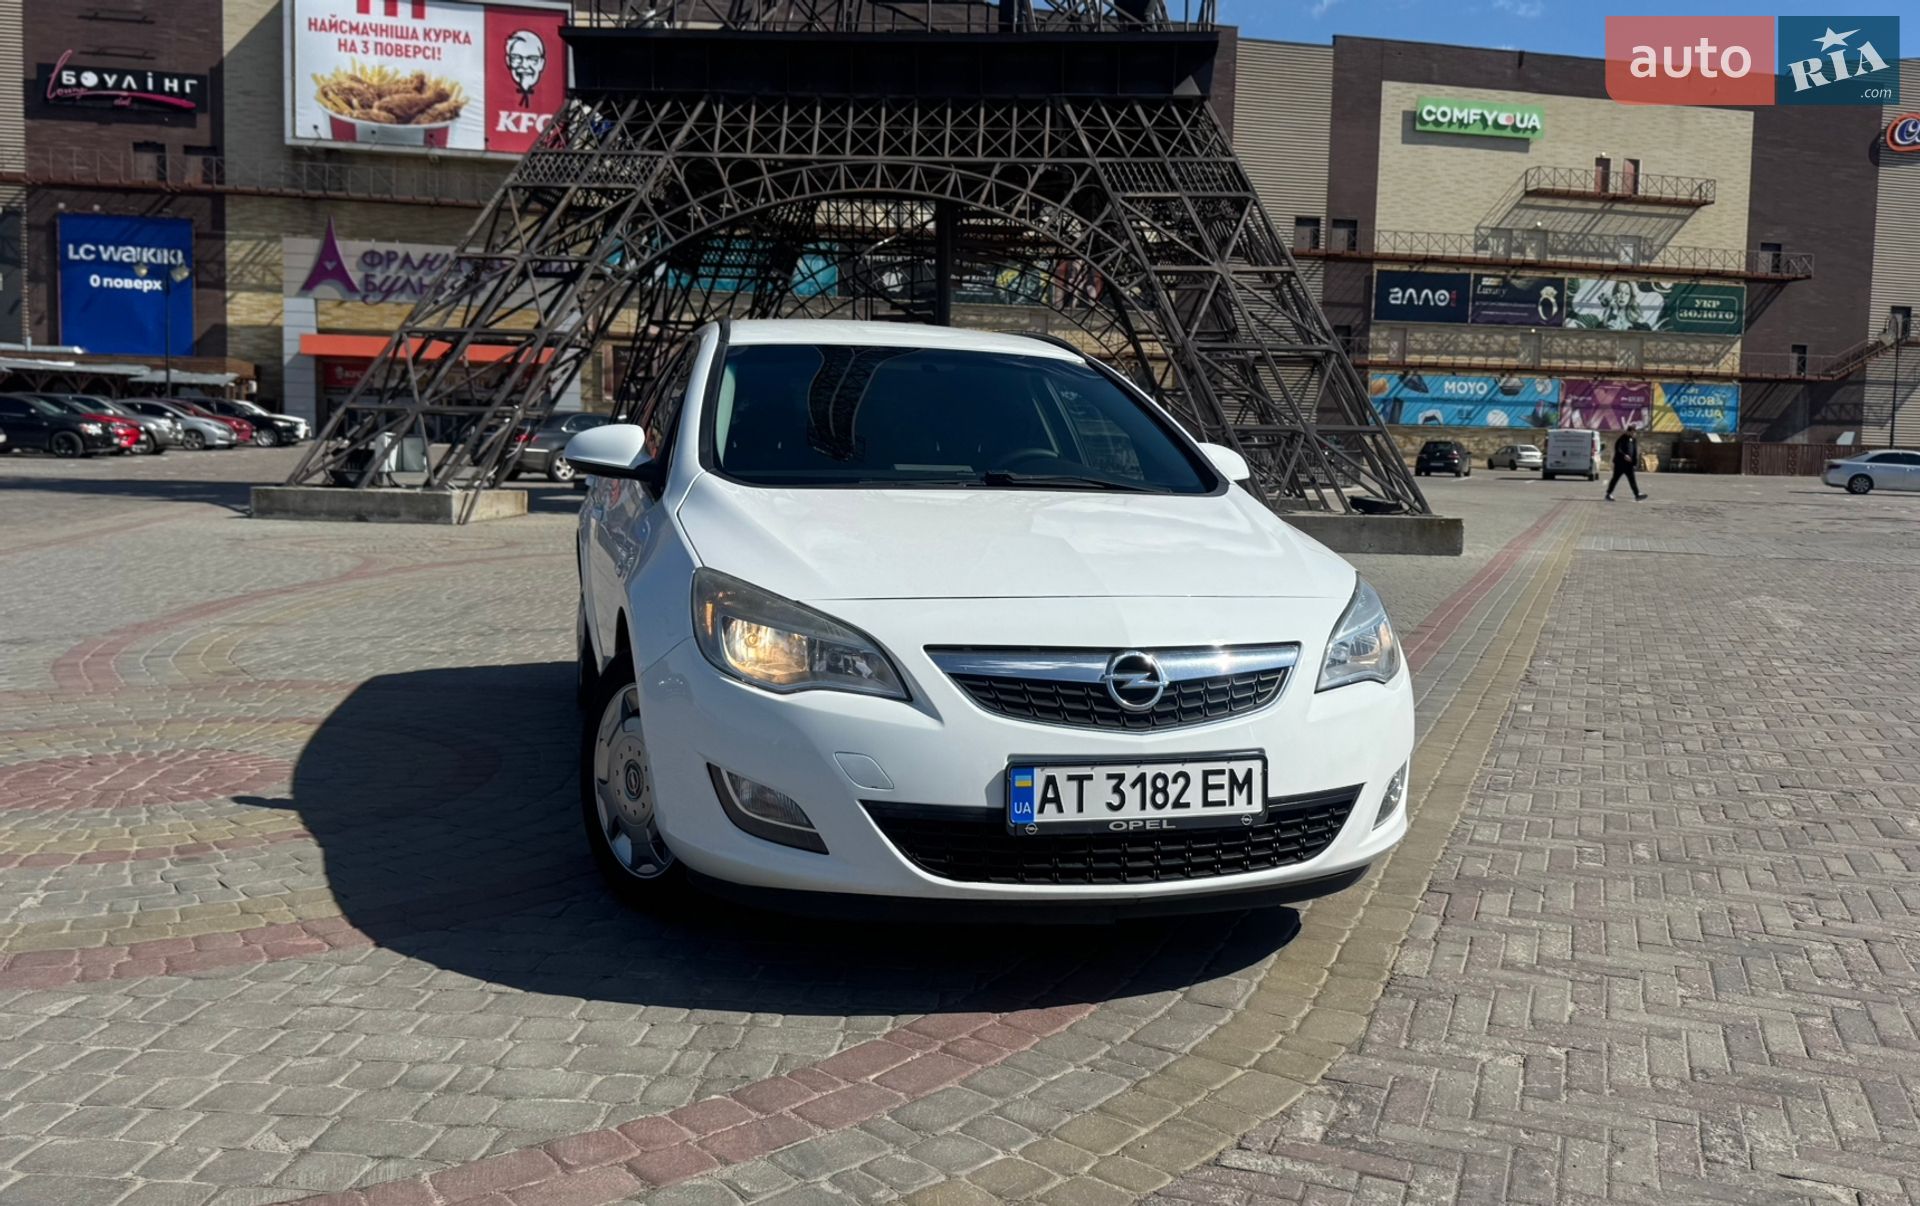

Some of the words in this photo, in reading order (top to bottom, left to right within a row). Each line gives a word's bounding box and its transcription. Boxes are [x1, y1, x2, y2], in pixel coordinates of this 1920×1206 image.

[307, 14, 420, 42] НАЙСМАЧНІША
[422, 27, 473, 47] КУРКА
[337, 38, 357, 54] НА
[360, 41, 371, 55] 3
[373, 43, 443, 61] ПОВЕРСІ!
[68, 243, 97, 260] LC
[103, 276, 163, 293] поверх
[1694, 299, 1721, 309] УКР
[1679, 310, 1735, 321] ЗОЛОТО
[1443, 380, 1488, 395] MOYO
[1014, 801, 1033, 815] UA
[1037, 774, 1094, 814] AT
[1105, 770, 1192, 812] 3182
[1202, 767, 1253, 808] EM
[1108, 819, 1176, 831] OPEL
